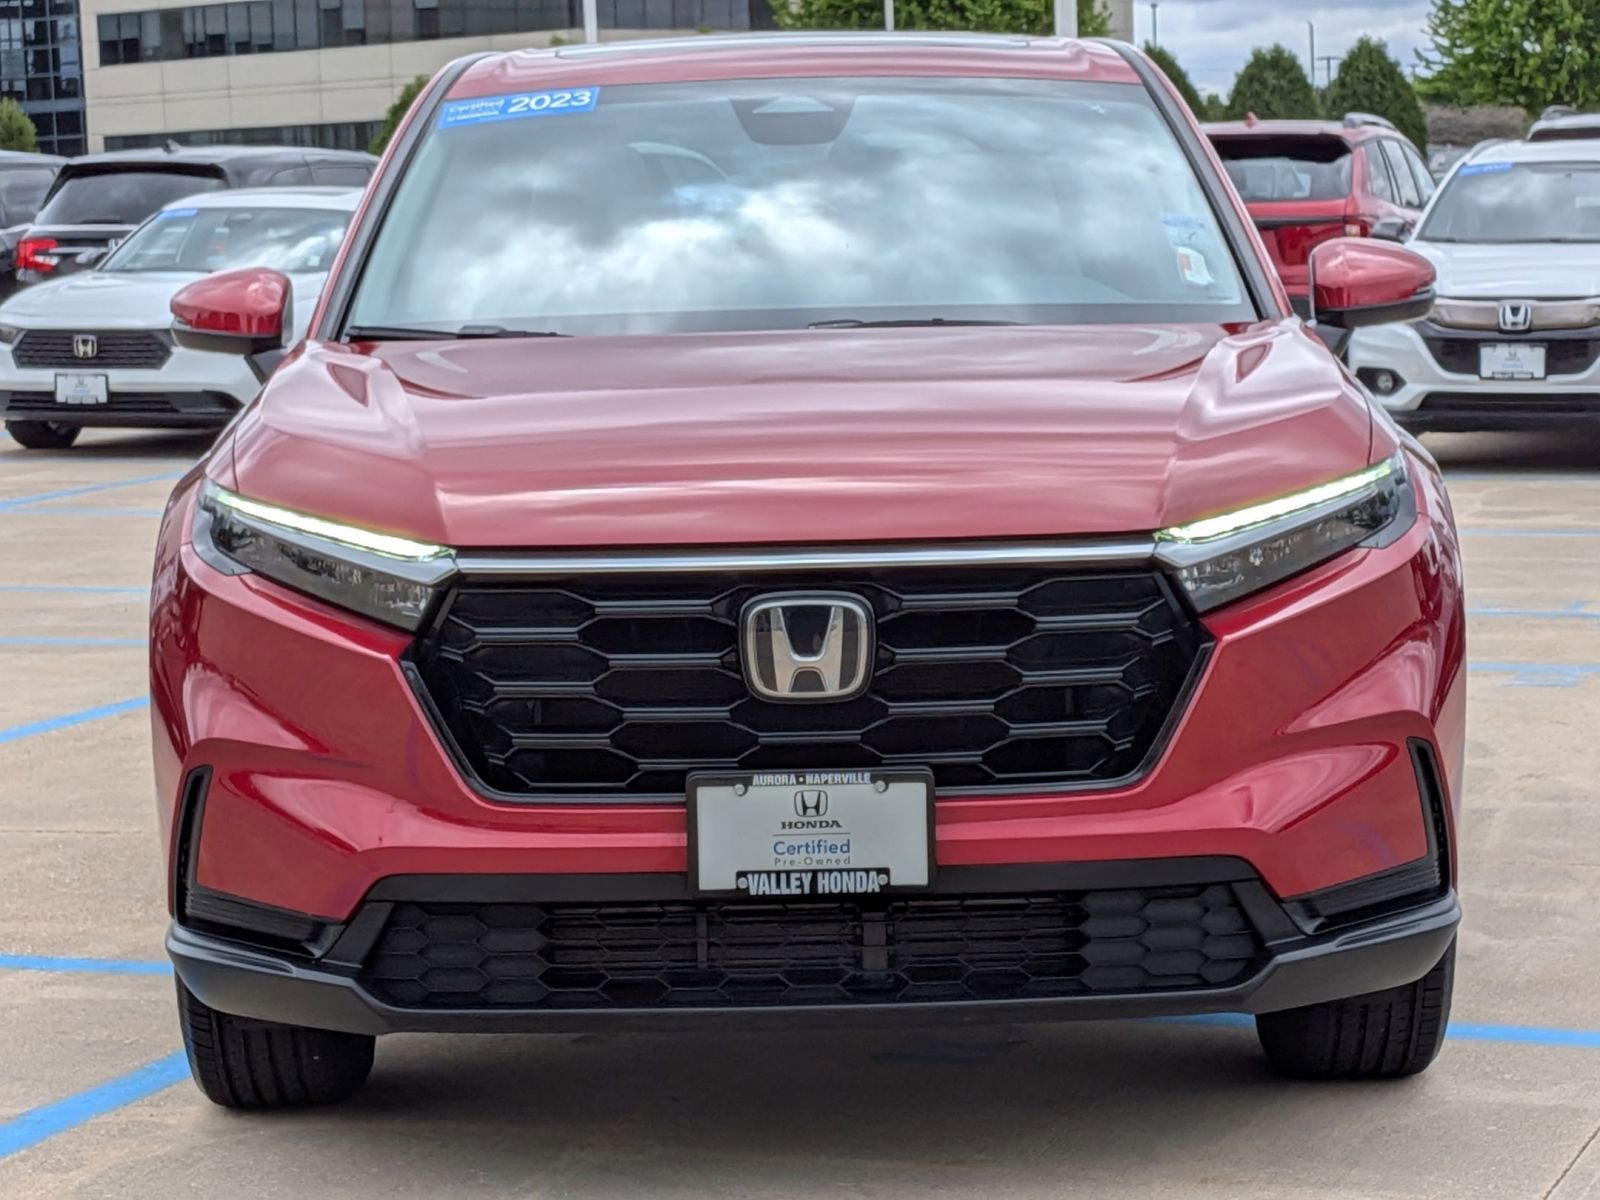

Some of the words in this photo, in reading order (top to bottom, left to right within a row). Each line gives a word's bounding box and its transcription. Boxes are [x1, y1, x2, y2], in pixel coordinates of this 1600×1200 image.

[507, 91, 592, 113] 2023
[752, 774, 796, 786] AURORA
[805, 772, 872, 785] NAPERVILLE
[781, 820, 842, 829] HONDA
[773, 838, 850, 855] Certified
[774, 857, 850, 866] Pre-Owned
[747, 872, 812, 895] VALLEY
[817, 871, 881, 893] HONDA
